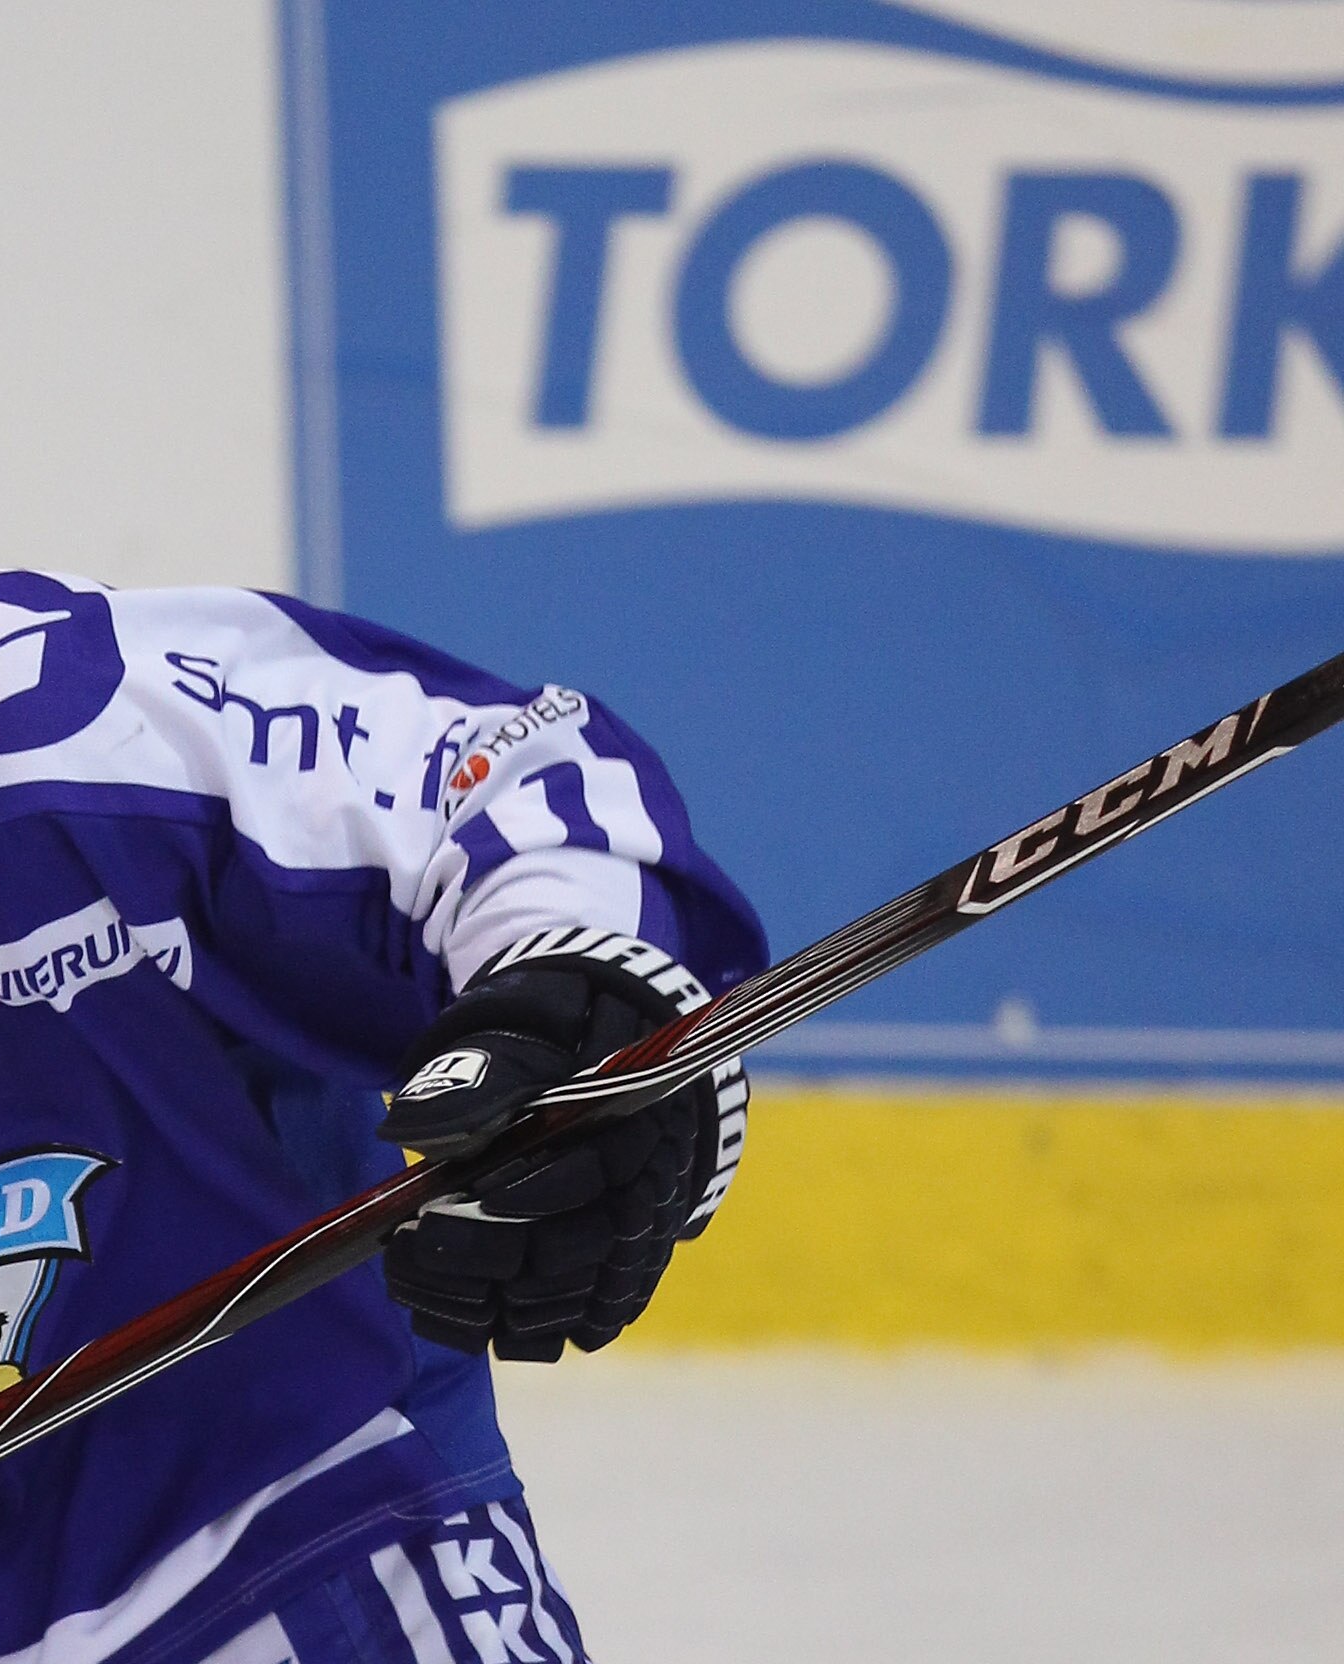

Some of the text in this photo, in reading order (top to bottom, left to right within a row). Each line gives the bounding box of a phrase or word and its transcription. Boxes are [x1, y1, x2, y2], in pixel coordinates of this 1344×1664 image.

[501, 157, 1344, 448] TORK
[479, 688, 582, 756] HOTELS
[988, 713, 1242, 884] CCM
